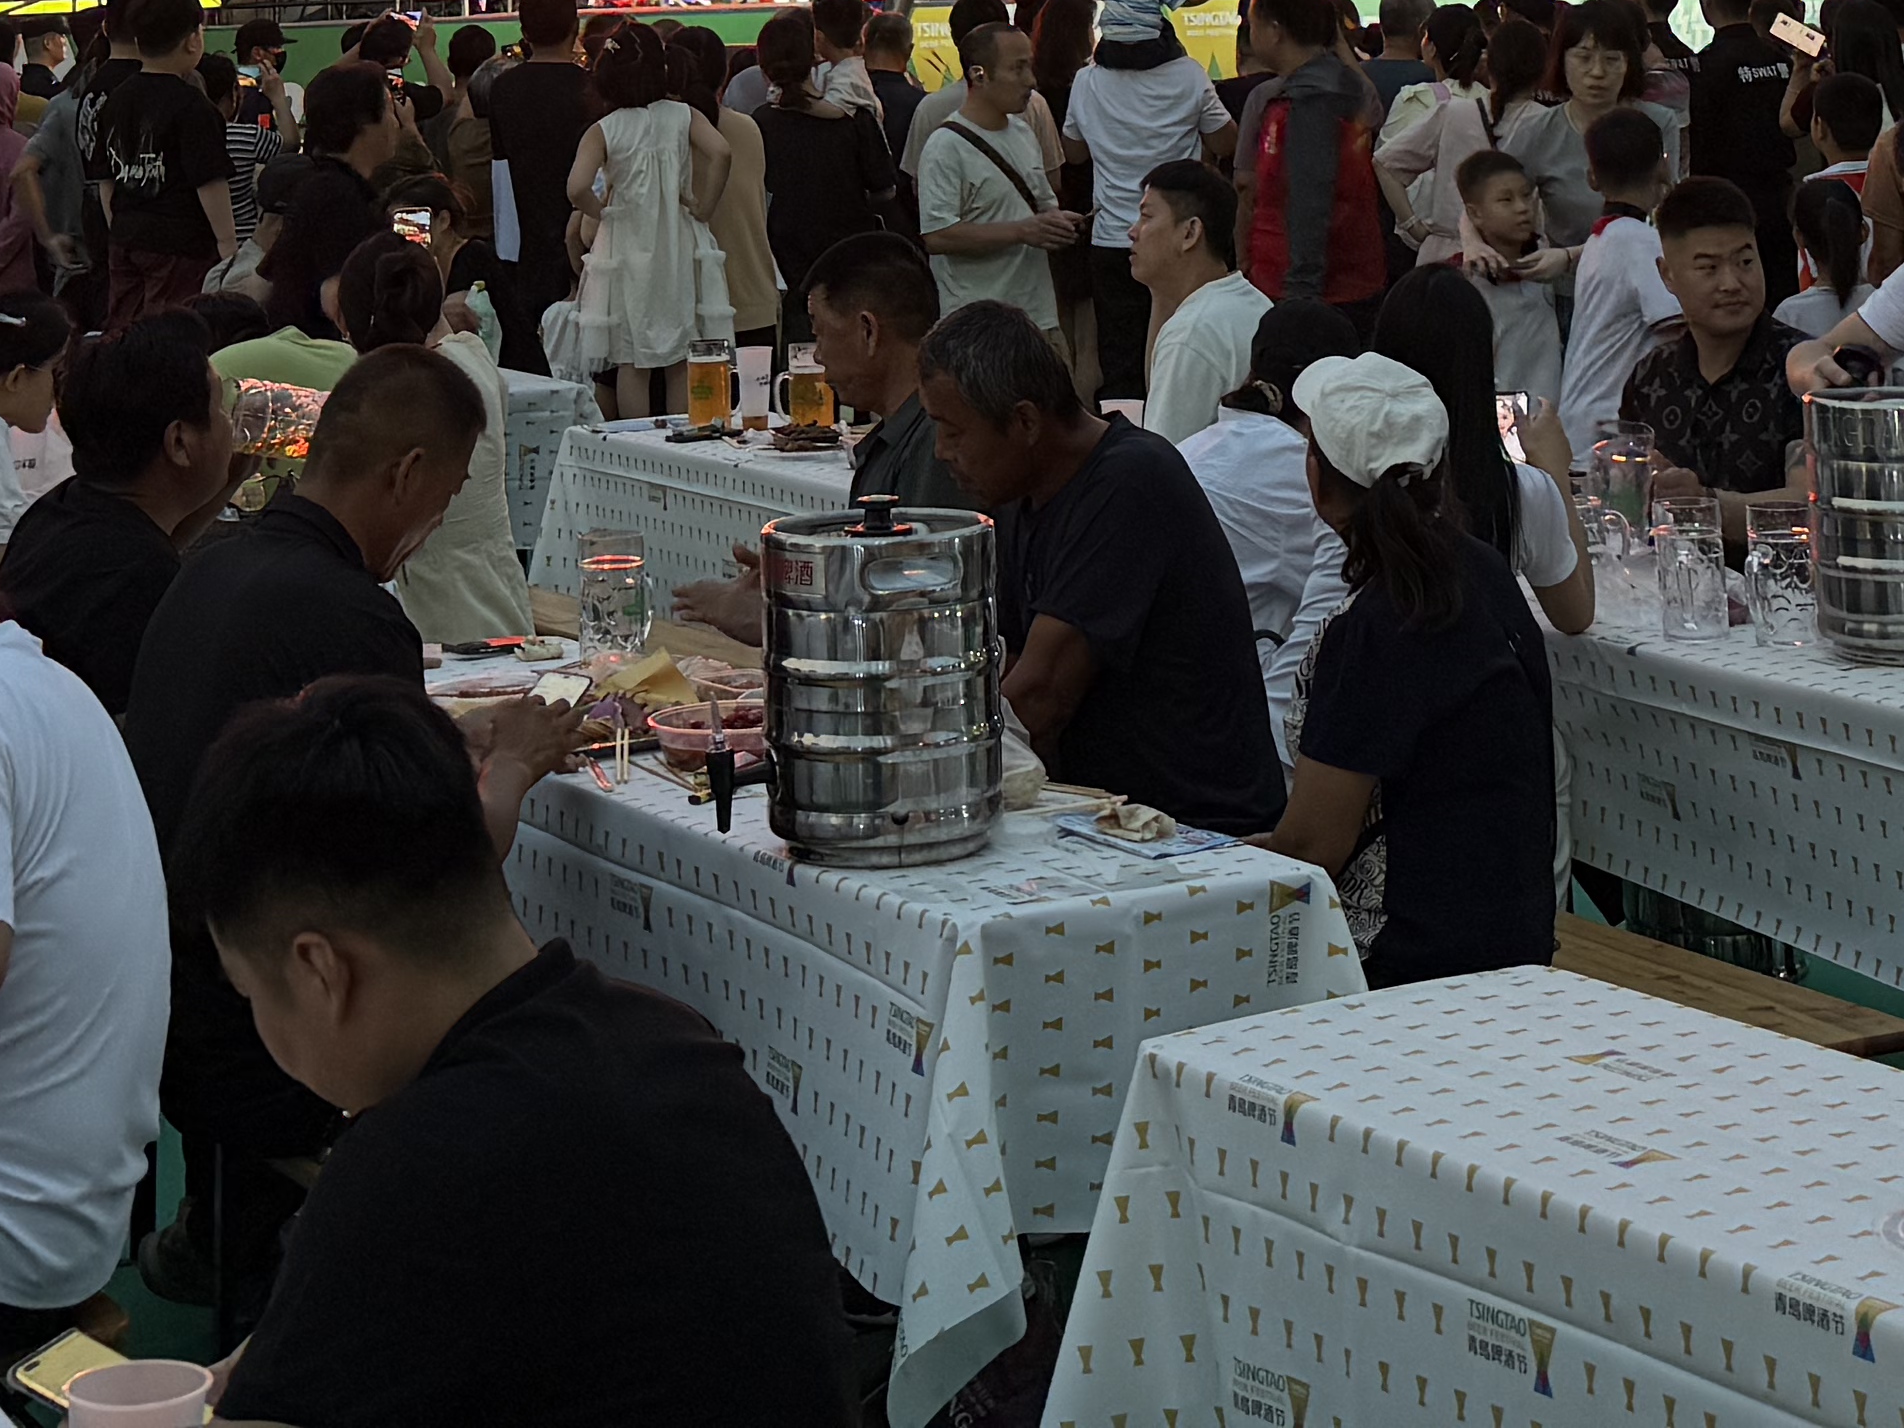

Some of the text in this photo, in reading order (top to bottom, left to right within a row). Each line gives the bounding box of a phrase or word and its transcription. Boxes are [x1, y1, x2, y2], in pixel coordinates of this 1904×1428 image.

[1266, 914, 1282, 988] TSINGTAO
[1467, 1297, 1527, 1338] TSINGTAO
[1232, 1355, 1286, 1393] TSINGTAO
